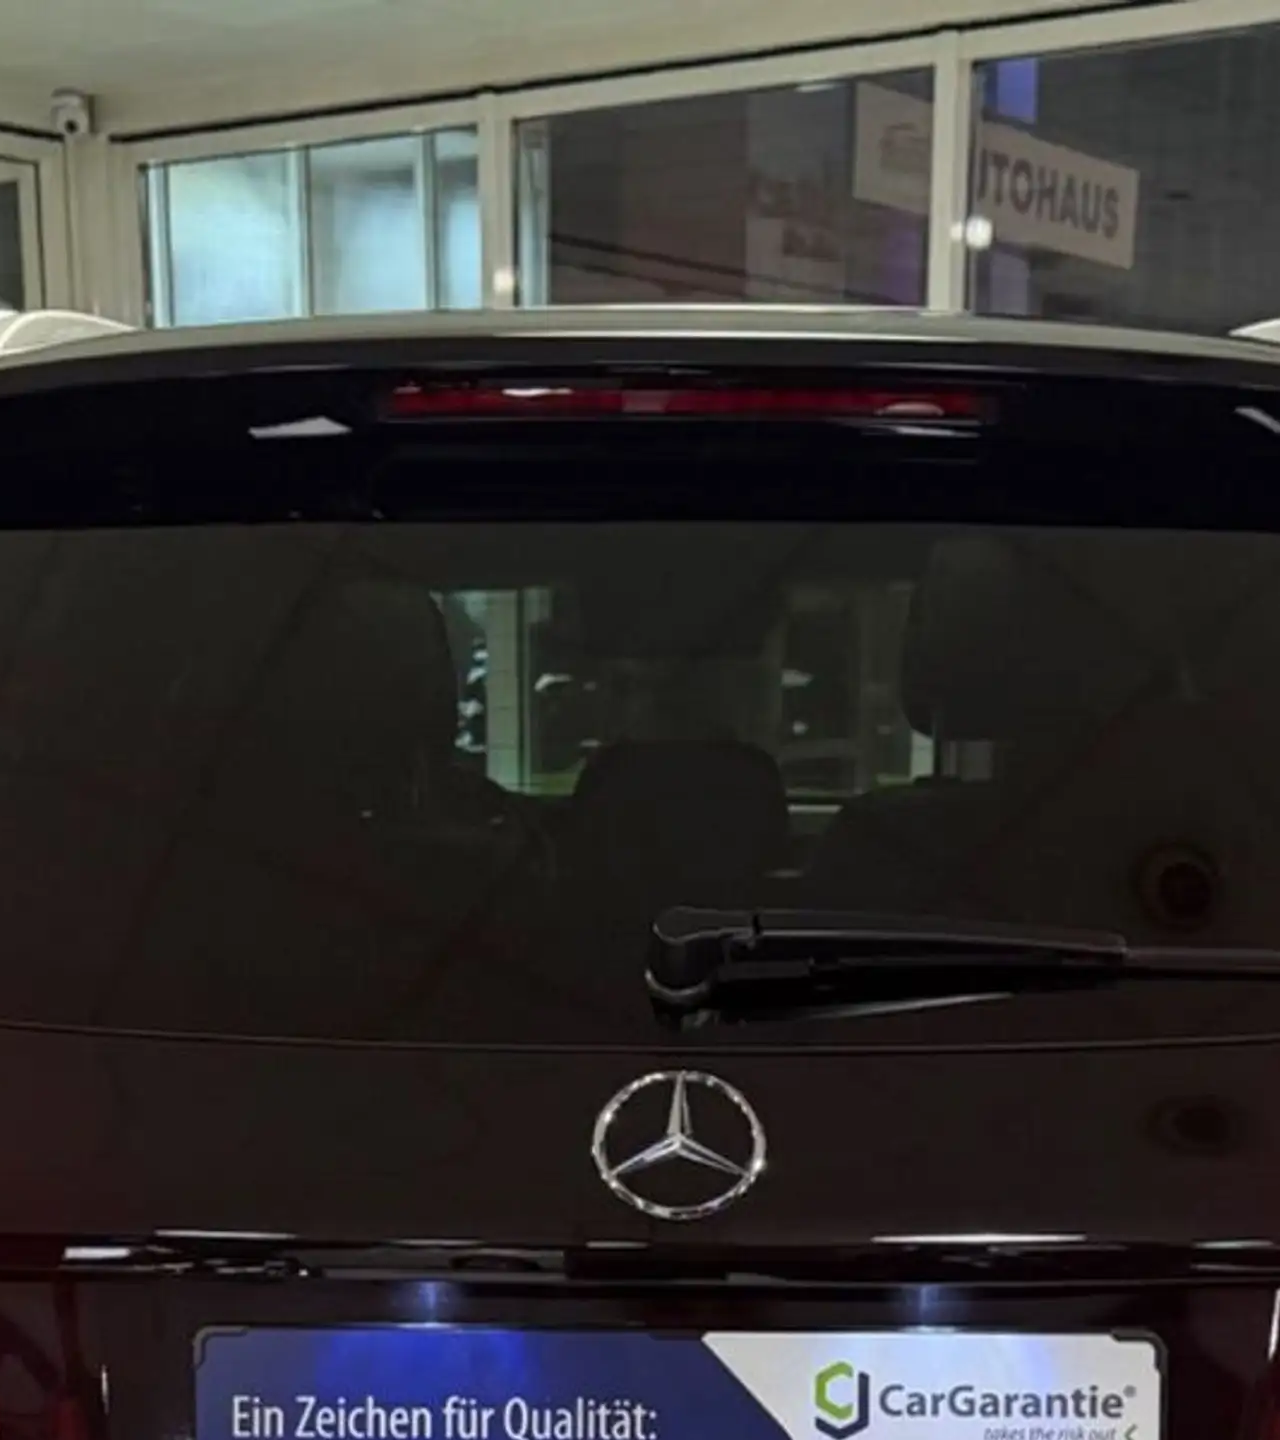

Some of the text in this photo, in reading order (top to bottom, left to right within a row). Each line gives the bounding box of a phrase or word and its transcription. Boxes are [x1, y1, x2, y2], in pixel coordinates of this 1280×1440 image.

[231, 1395, 284, 1439] Ein
[294, 1395, 432, 1440] Zeichen
[442, 1395, 494, 1440] für
[878, 1384, 1125, 1420] CarGarantie
